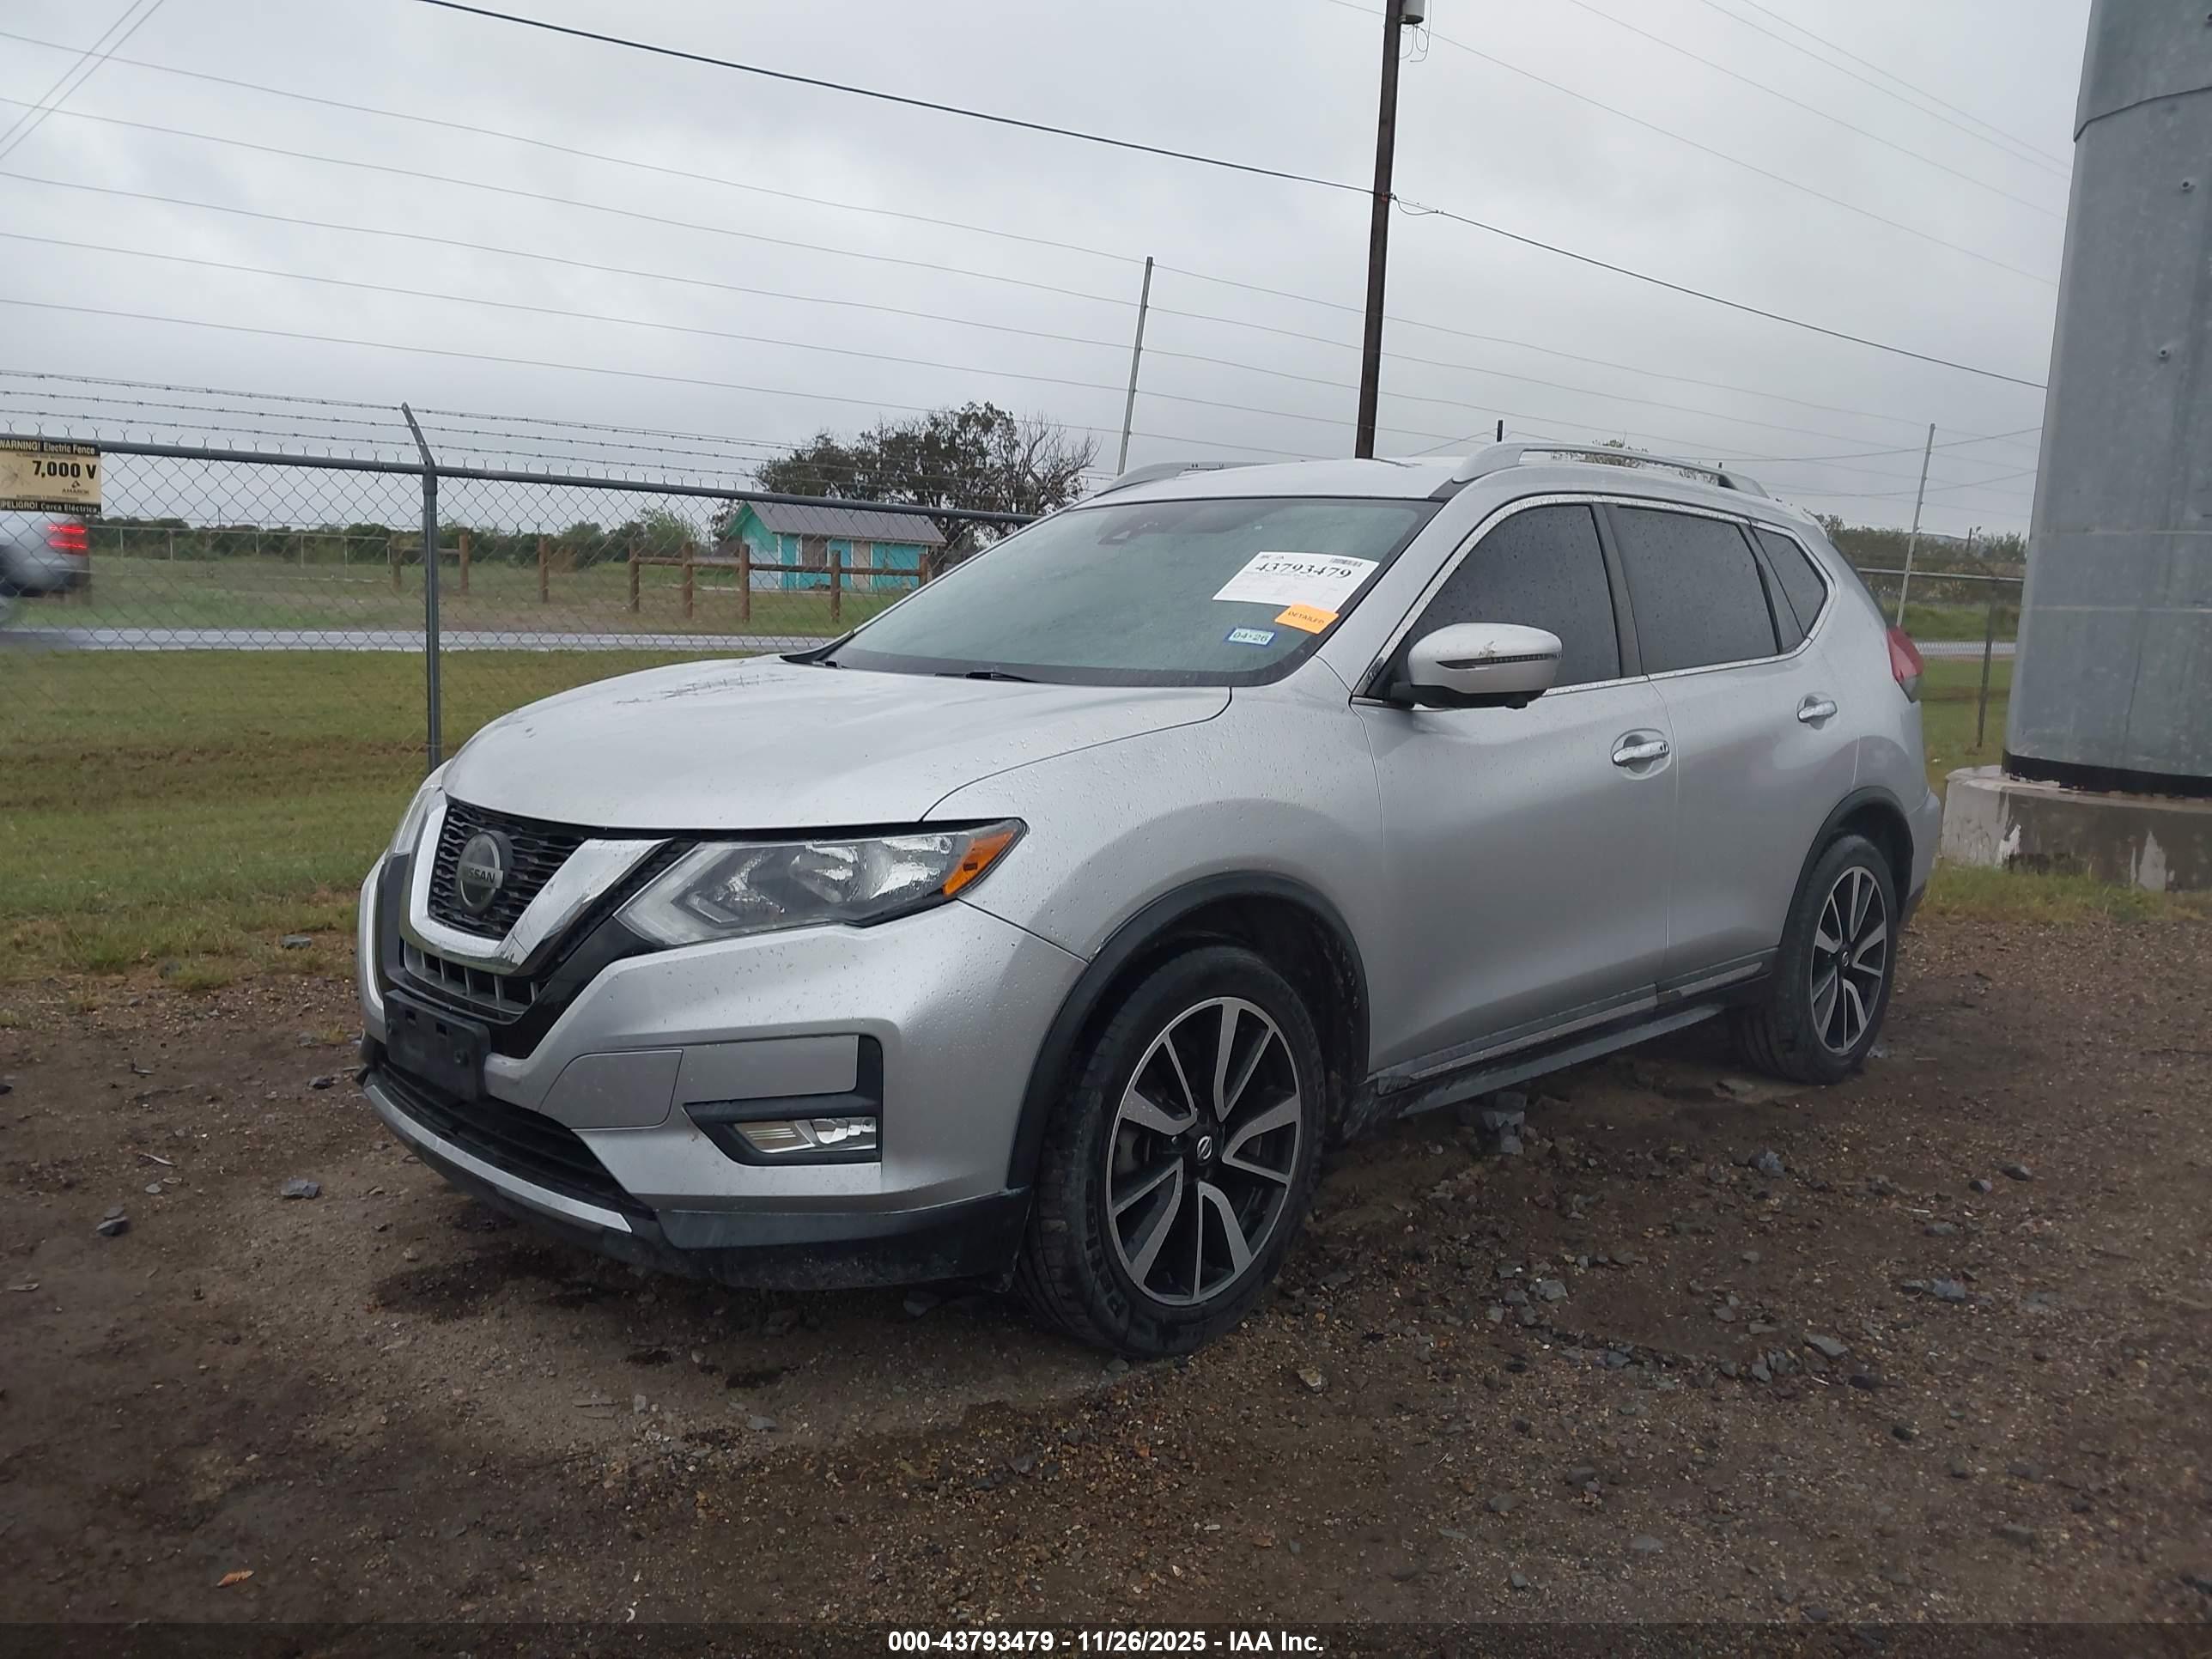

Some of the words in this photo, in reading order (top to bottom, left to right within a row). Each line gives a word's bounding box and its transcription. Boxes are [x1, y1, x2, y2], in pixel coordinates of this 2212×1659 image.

[43, 442, 71, 453] Electric
[73, 445, 95, 455] Fence
[32, 459, 81, 478] 7,000
[85, 464, 97, 479] V
[40, 502, 63, 512] Cerca
[1255, 562, 1352, 579] 43793479
[462, 866, 495, 884] SSAN
